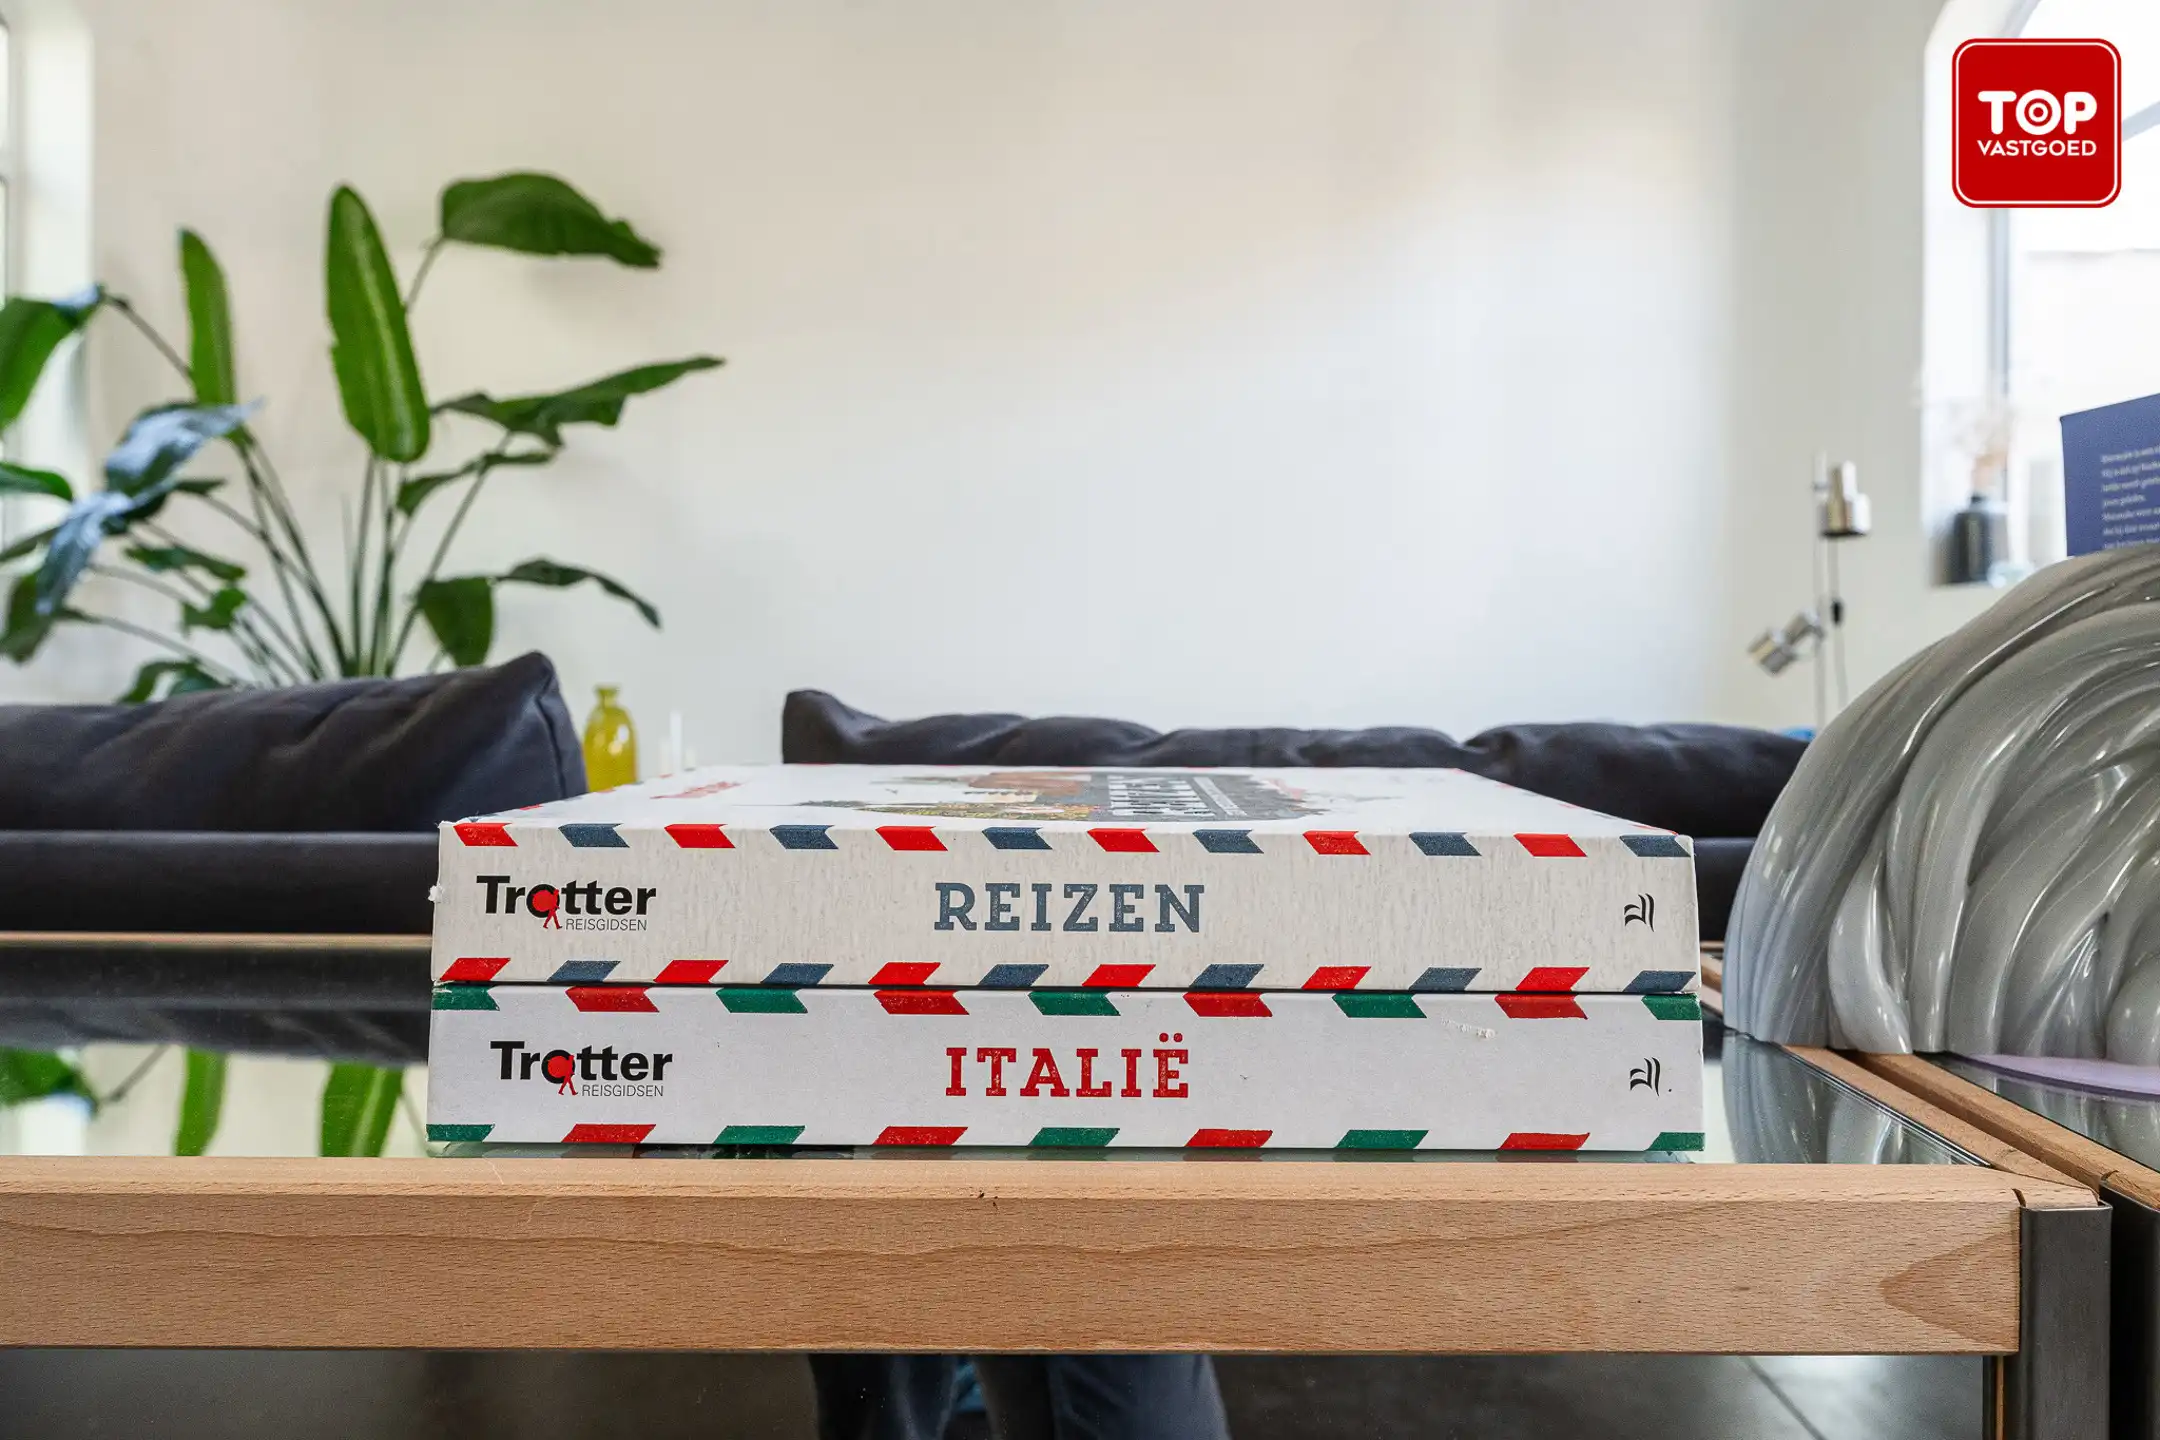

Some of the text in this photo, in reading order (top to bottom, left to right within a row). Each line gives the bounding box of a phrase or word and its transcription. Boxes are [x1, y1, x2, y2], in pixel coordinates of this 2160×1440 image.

[476, 875, 657, 919] Trotter
[934, 882, 1205, 933] REIZEN
[565, 918, 647, 931] REISGIDSEN
[490, 1041, 673, 1085] Trotter
[945, 1032, 1189, 1098] ITALIË
[581, 1084, 664, 1097] REISGIDSEN
